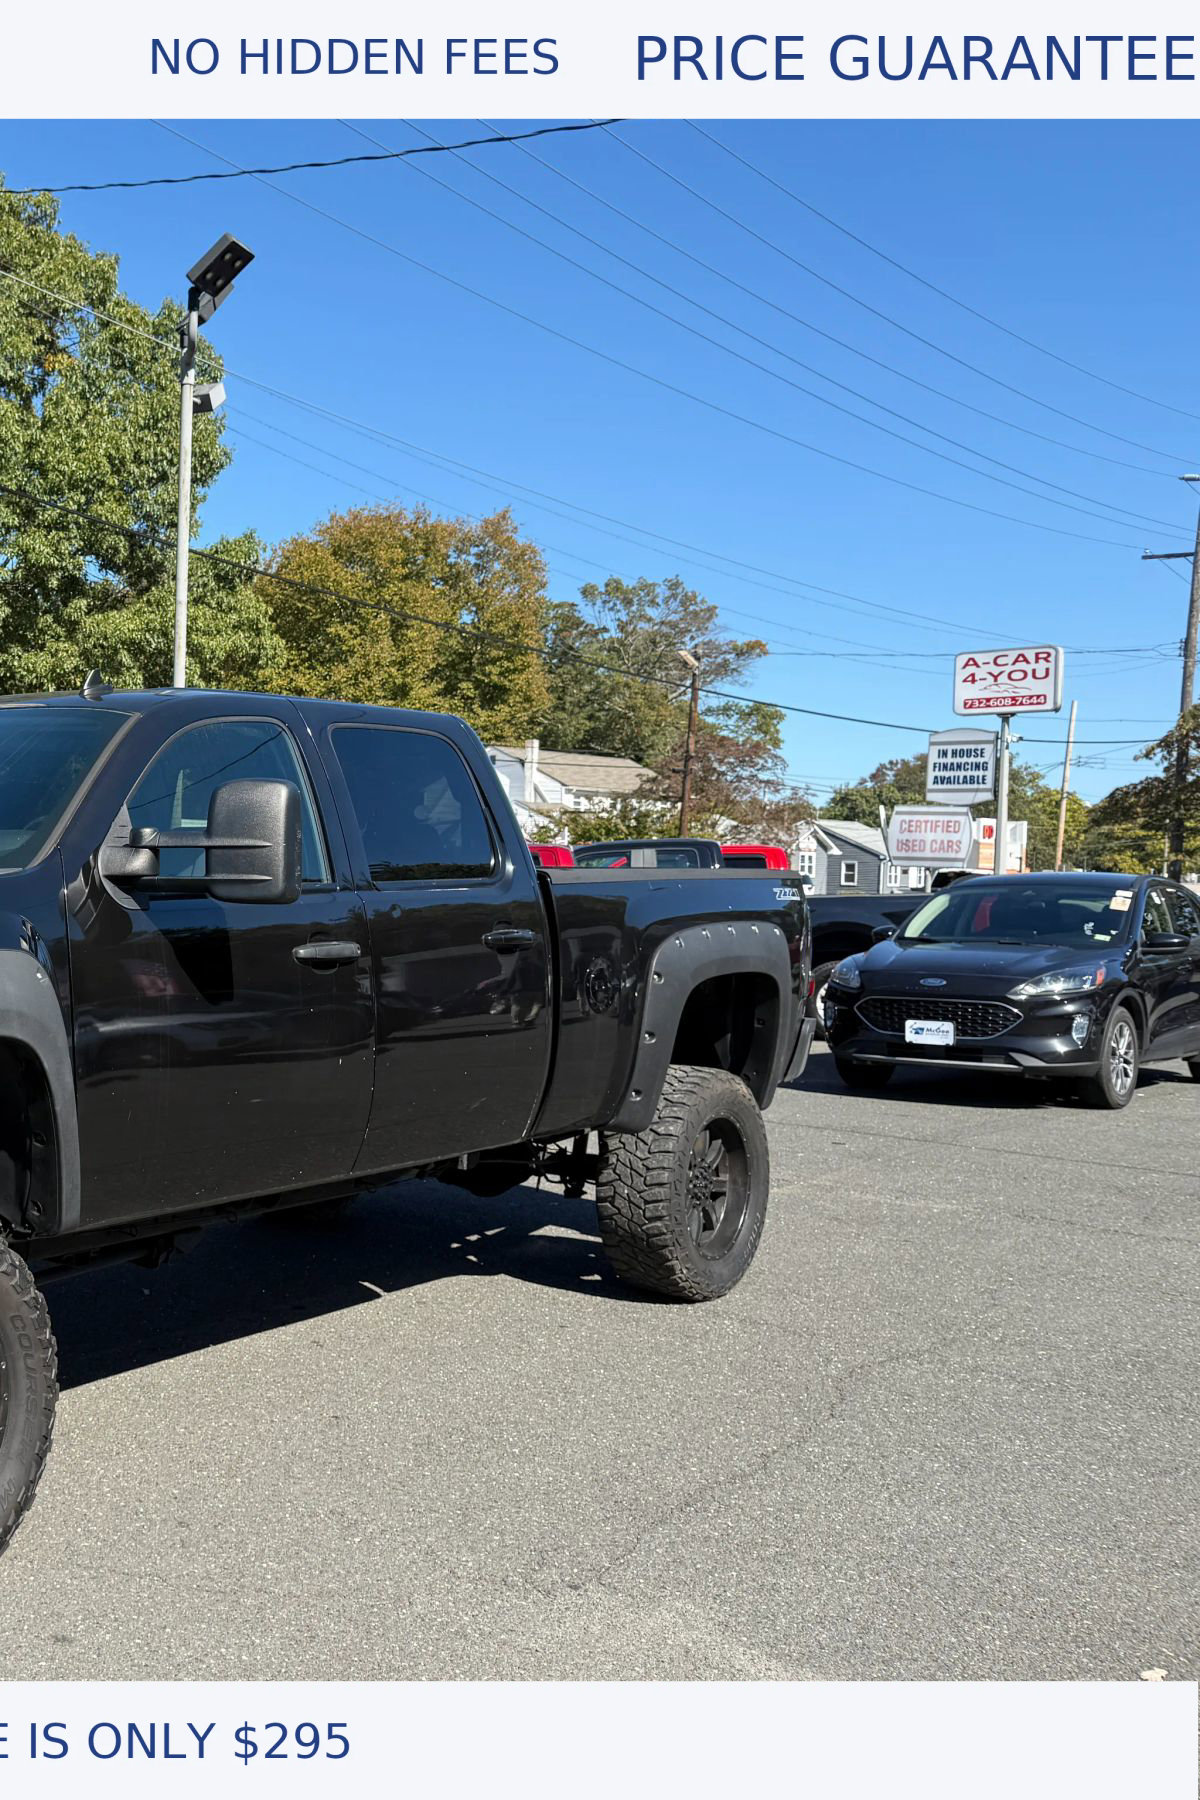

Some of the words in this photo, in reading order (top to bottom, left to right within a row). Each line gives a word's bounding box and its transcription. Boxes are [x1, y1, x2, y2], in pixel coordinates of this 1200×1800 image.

[962, 651, 1052, 669] A-CAR
[962, 667, 1050, 684] 4-YOU
[964, 695, 1045, 708] 732-608-7644
[937, 749, 949, 759] IN
[951, 748, 986, 759] HOUSE
[933, 761, 989, 772] FINANCING
[932, 775, 987, 785] AVAILABLE
[899, 819, 961, 834] CERTIFIED
[896, 839, 926, 853] USED
[930, 839, 962, 854] CARS
